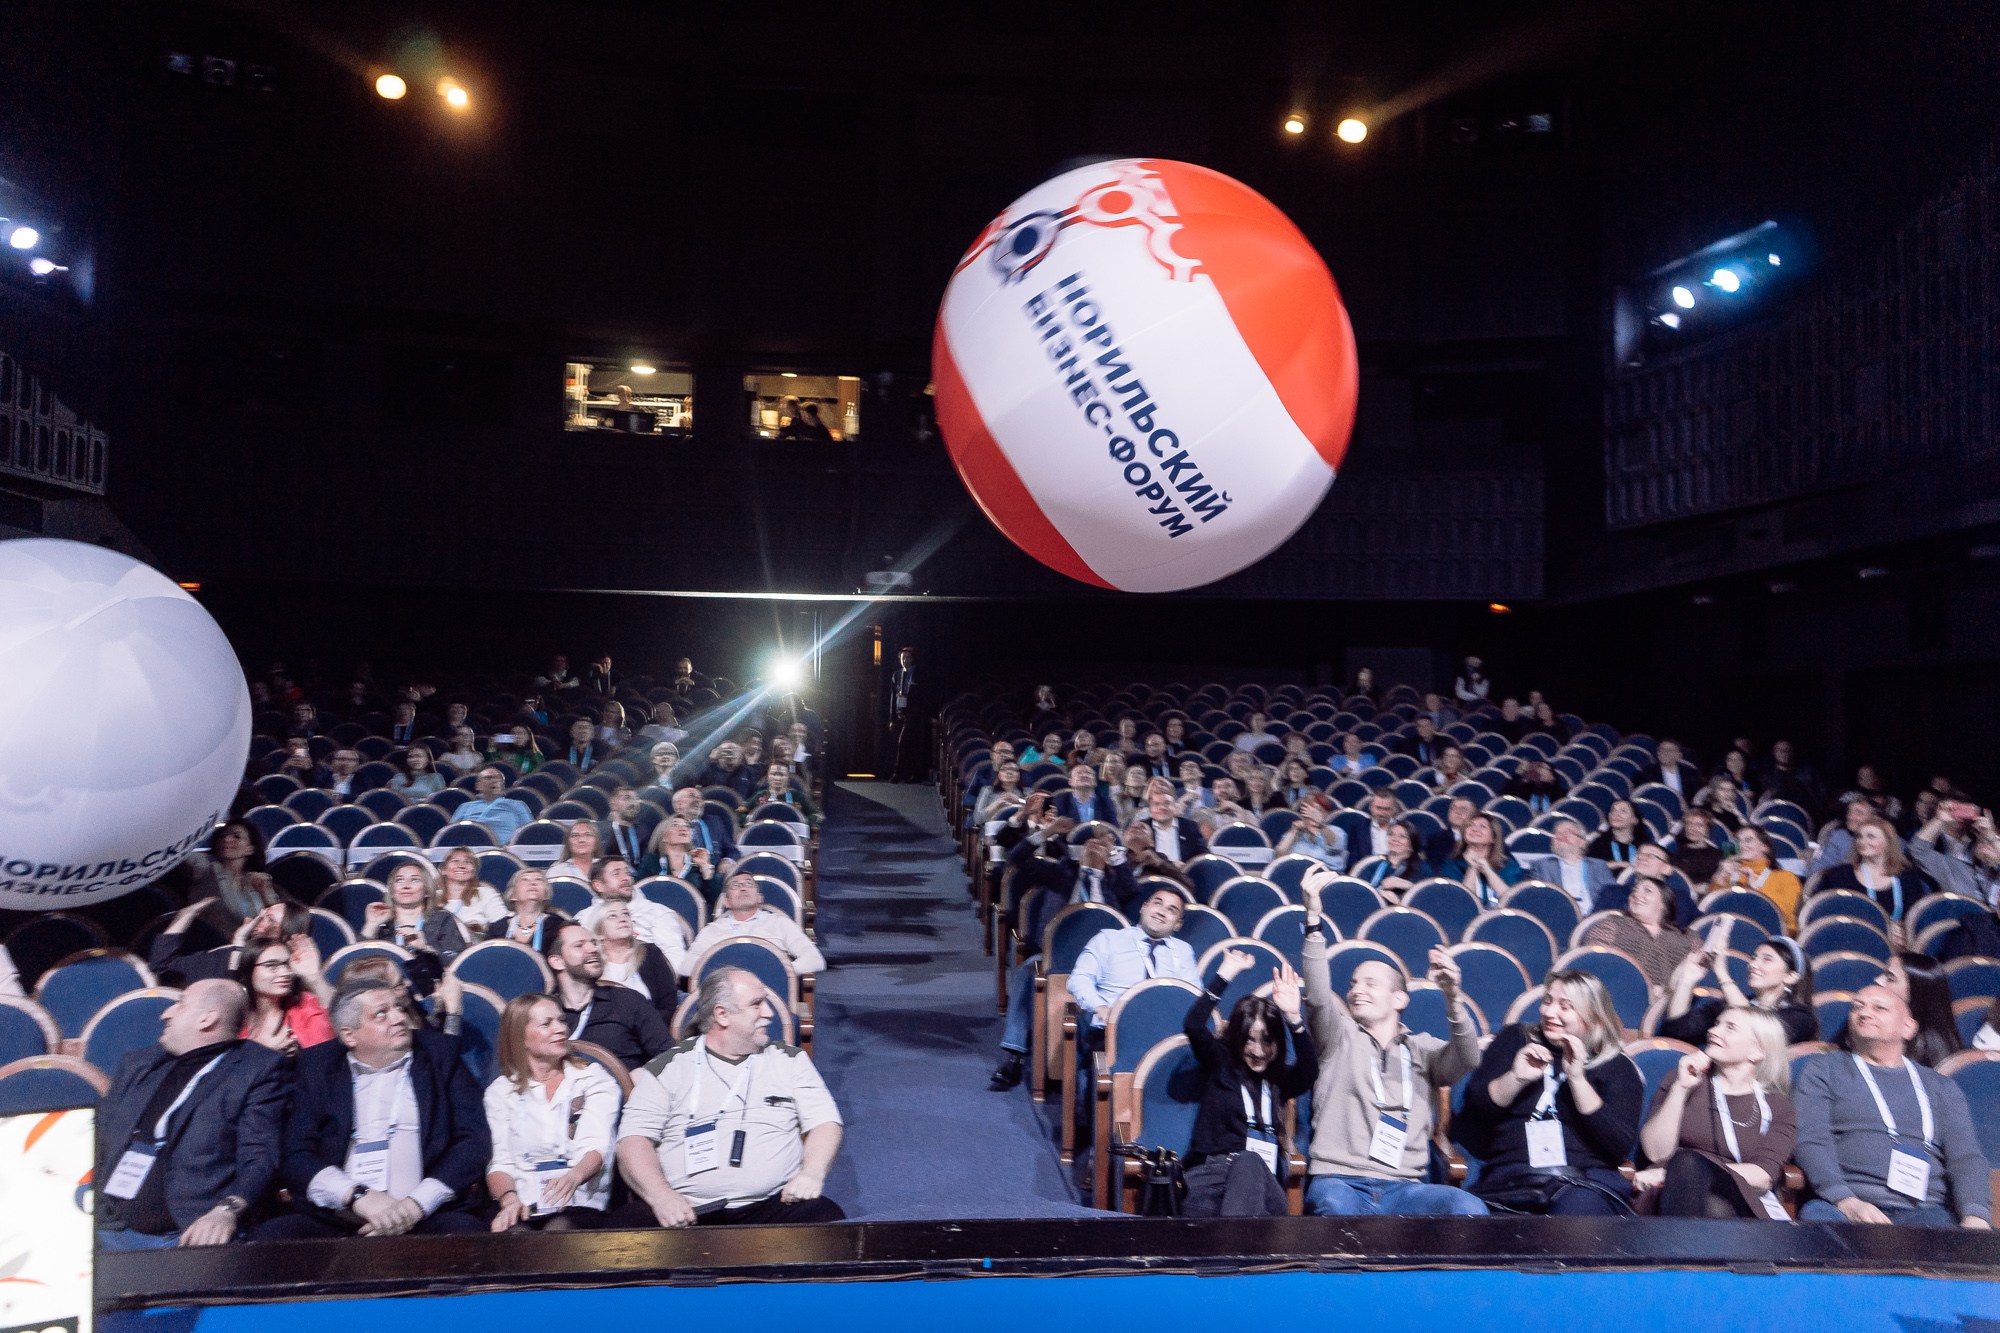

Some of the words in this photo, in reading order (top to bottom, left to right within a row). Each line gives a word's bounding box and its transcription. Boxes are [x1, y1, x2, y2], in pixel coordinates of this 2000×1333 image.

[1021, 291, 1196, 539] БИЗНЕС-ФОРУМ
[1053, 268, 1233, 524] НОРИЛЬСКИЙ
[0, 809, 218, 881] ОРИЛЬСКИЙ
